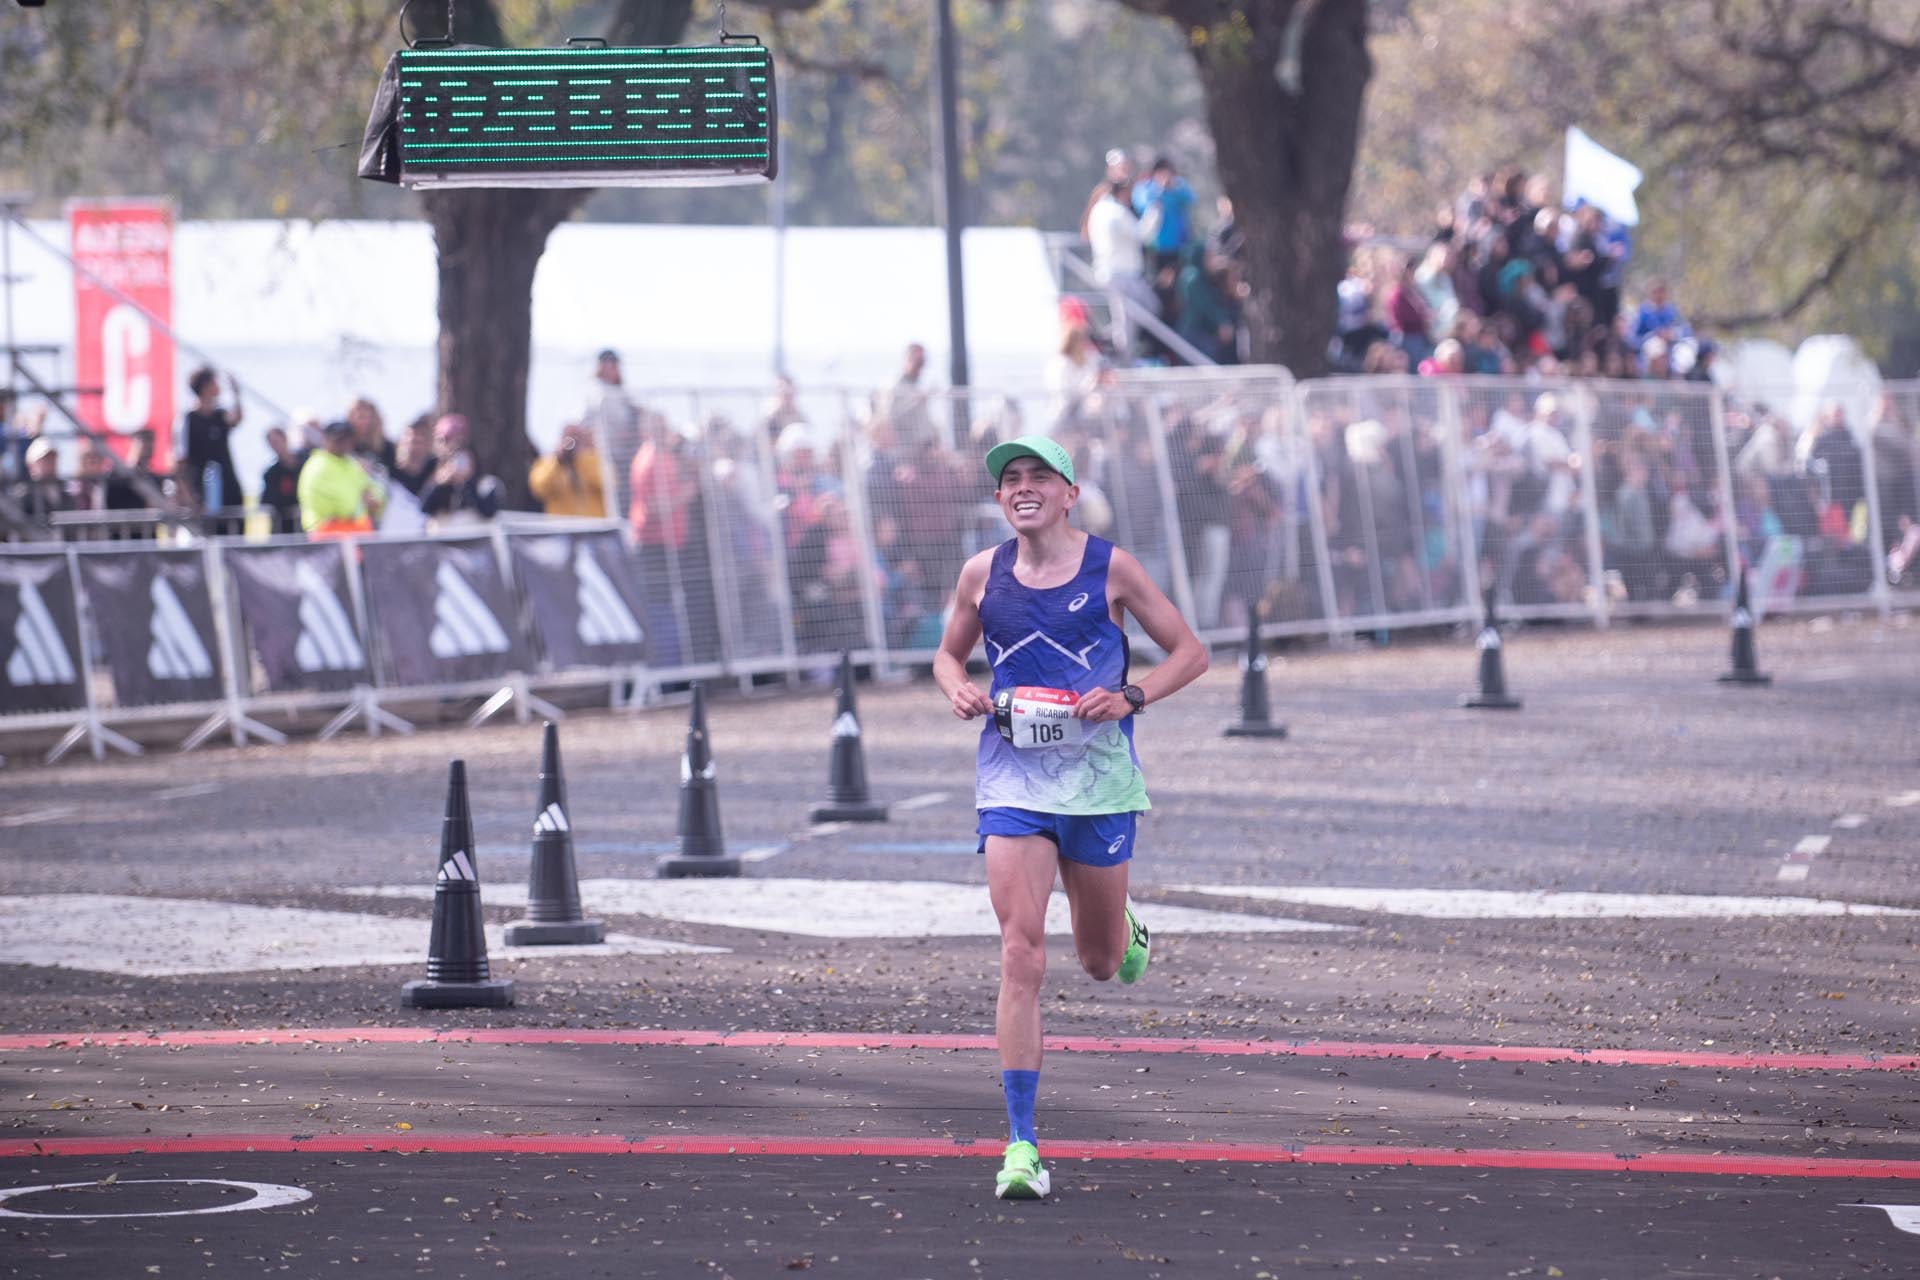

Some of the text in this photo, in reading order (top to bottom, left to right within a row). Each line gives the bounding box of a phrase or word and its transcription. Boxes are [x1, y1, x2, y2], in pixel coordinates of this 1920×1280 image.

[102, 304, 151, 433] C
[998, 692, 1009, 707] B
[1035, 707, 1069, 719] RICARDO
[1029, 723, 1064, 743] 105
